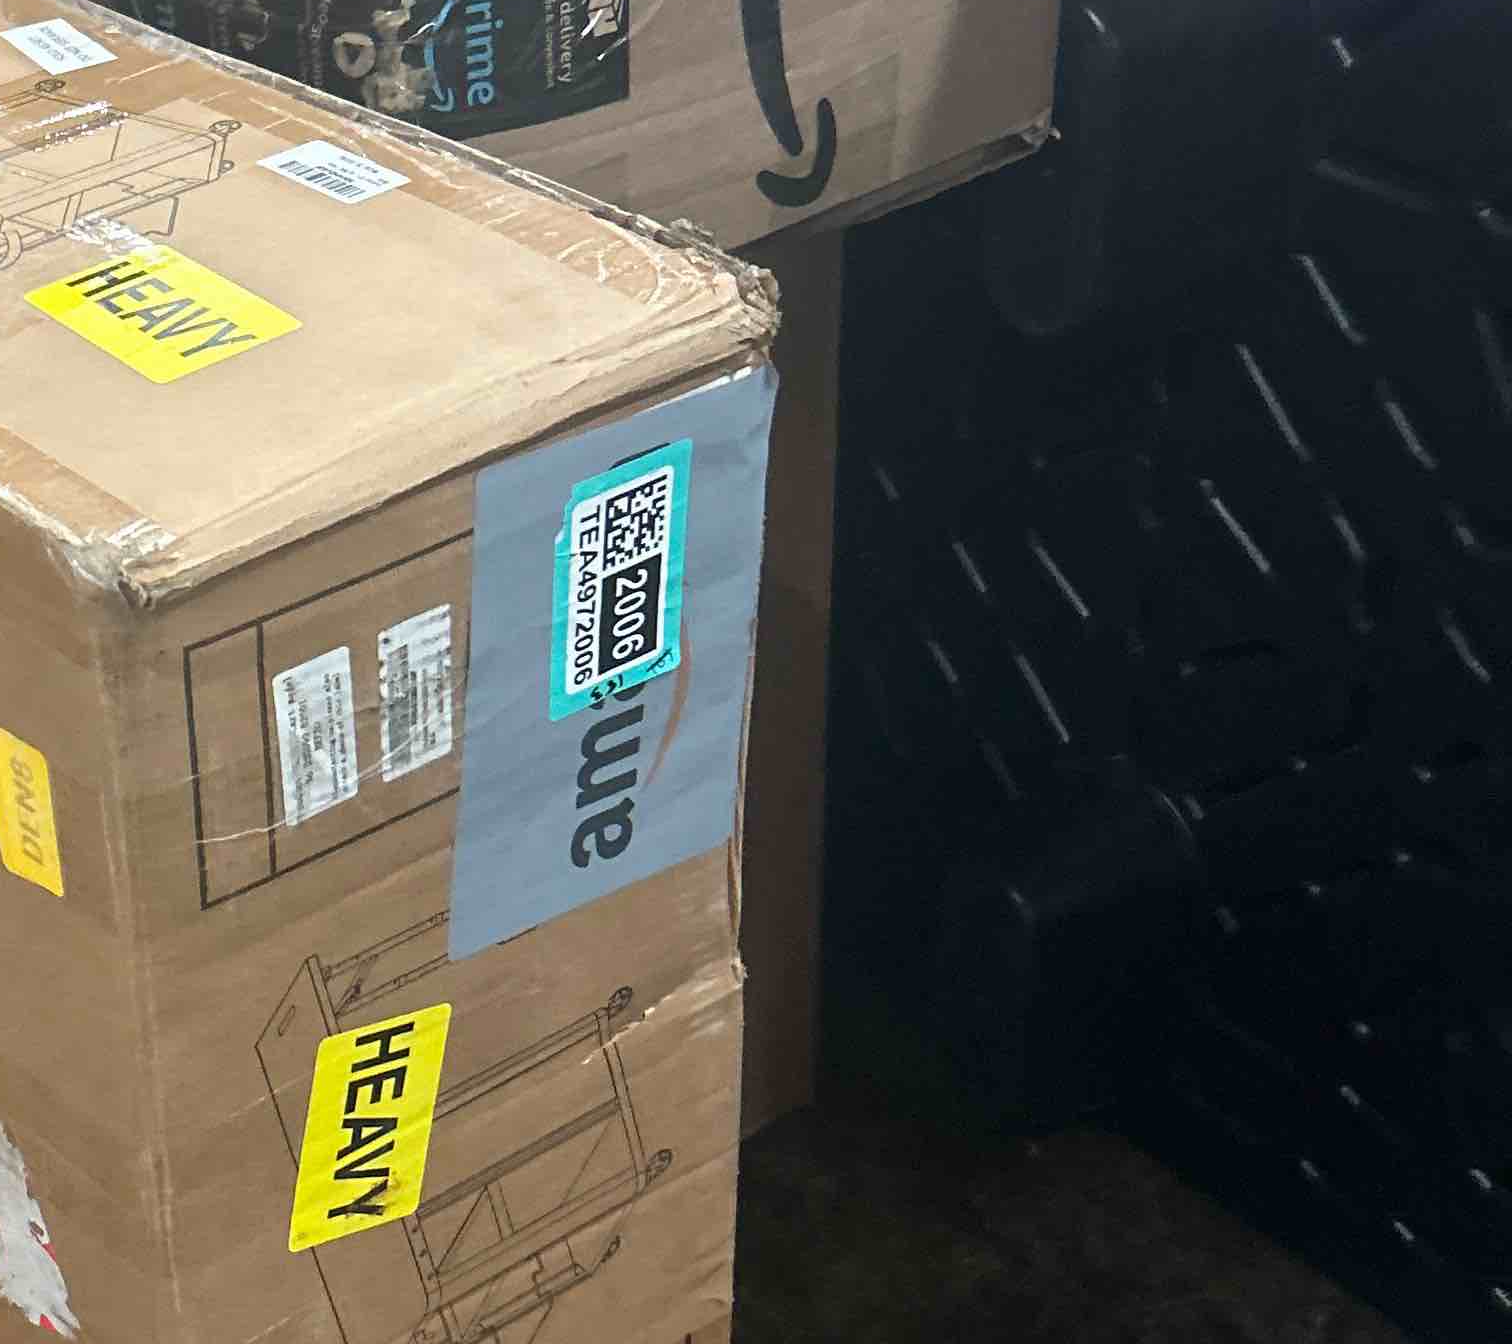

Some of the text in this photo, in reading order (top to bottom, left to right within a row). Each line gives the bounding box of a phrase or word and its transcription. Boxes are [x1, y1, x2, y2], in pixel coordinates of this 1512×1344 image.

[557, 1, 576, 84] delivery
[67, 261, 260, 358] HEAVY
[573, 504, 602, 686] TEA4972006
[611, 568, 649, 661] 2006
[327, 1019, 416, 1221] HEAVY
